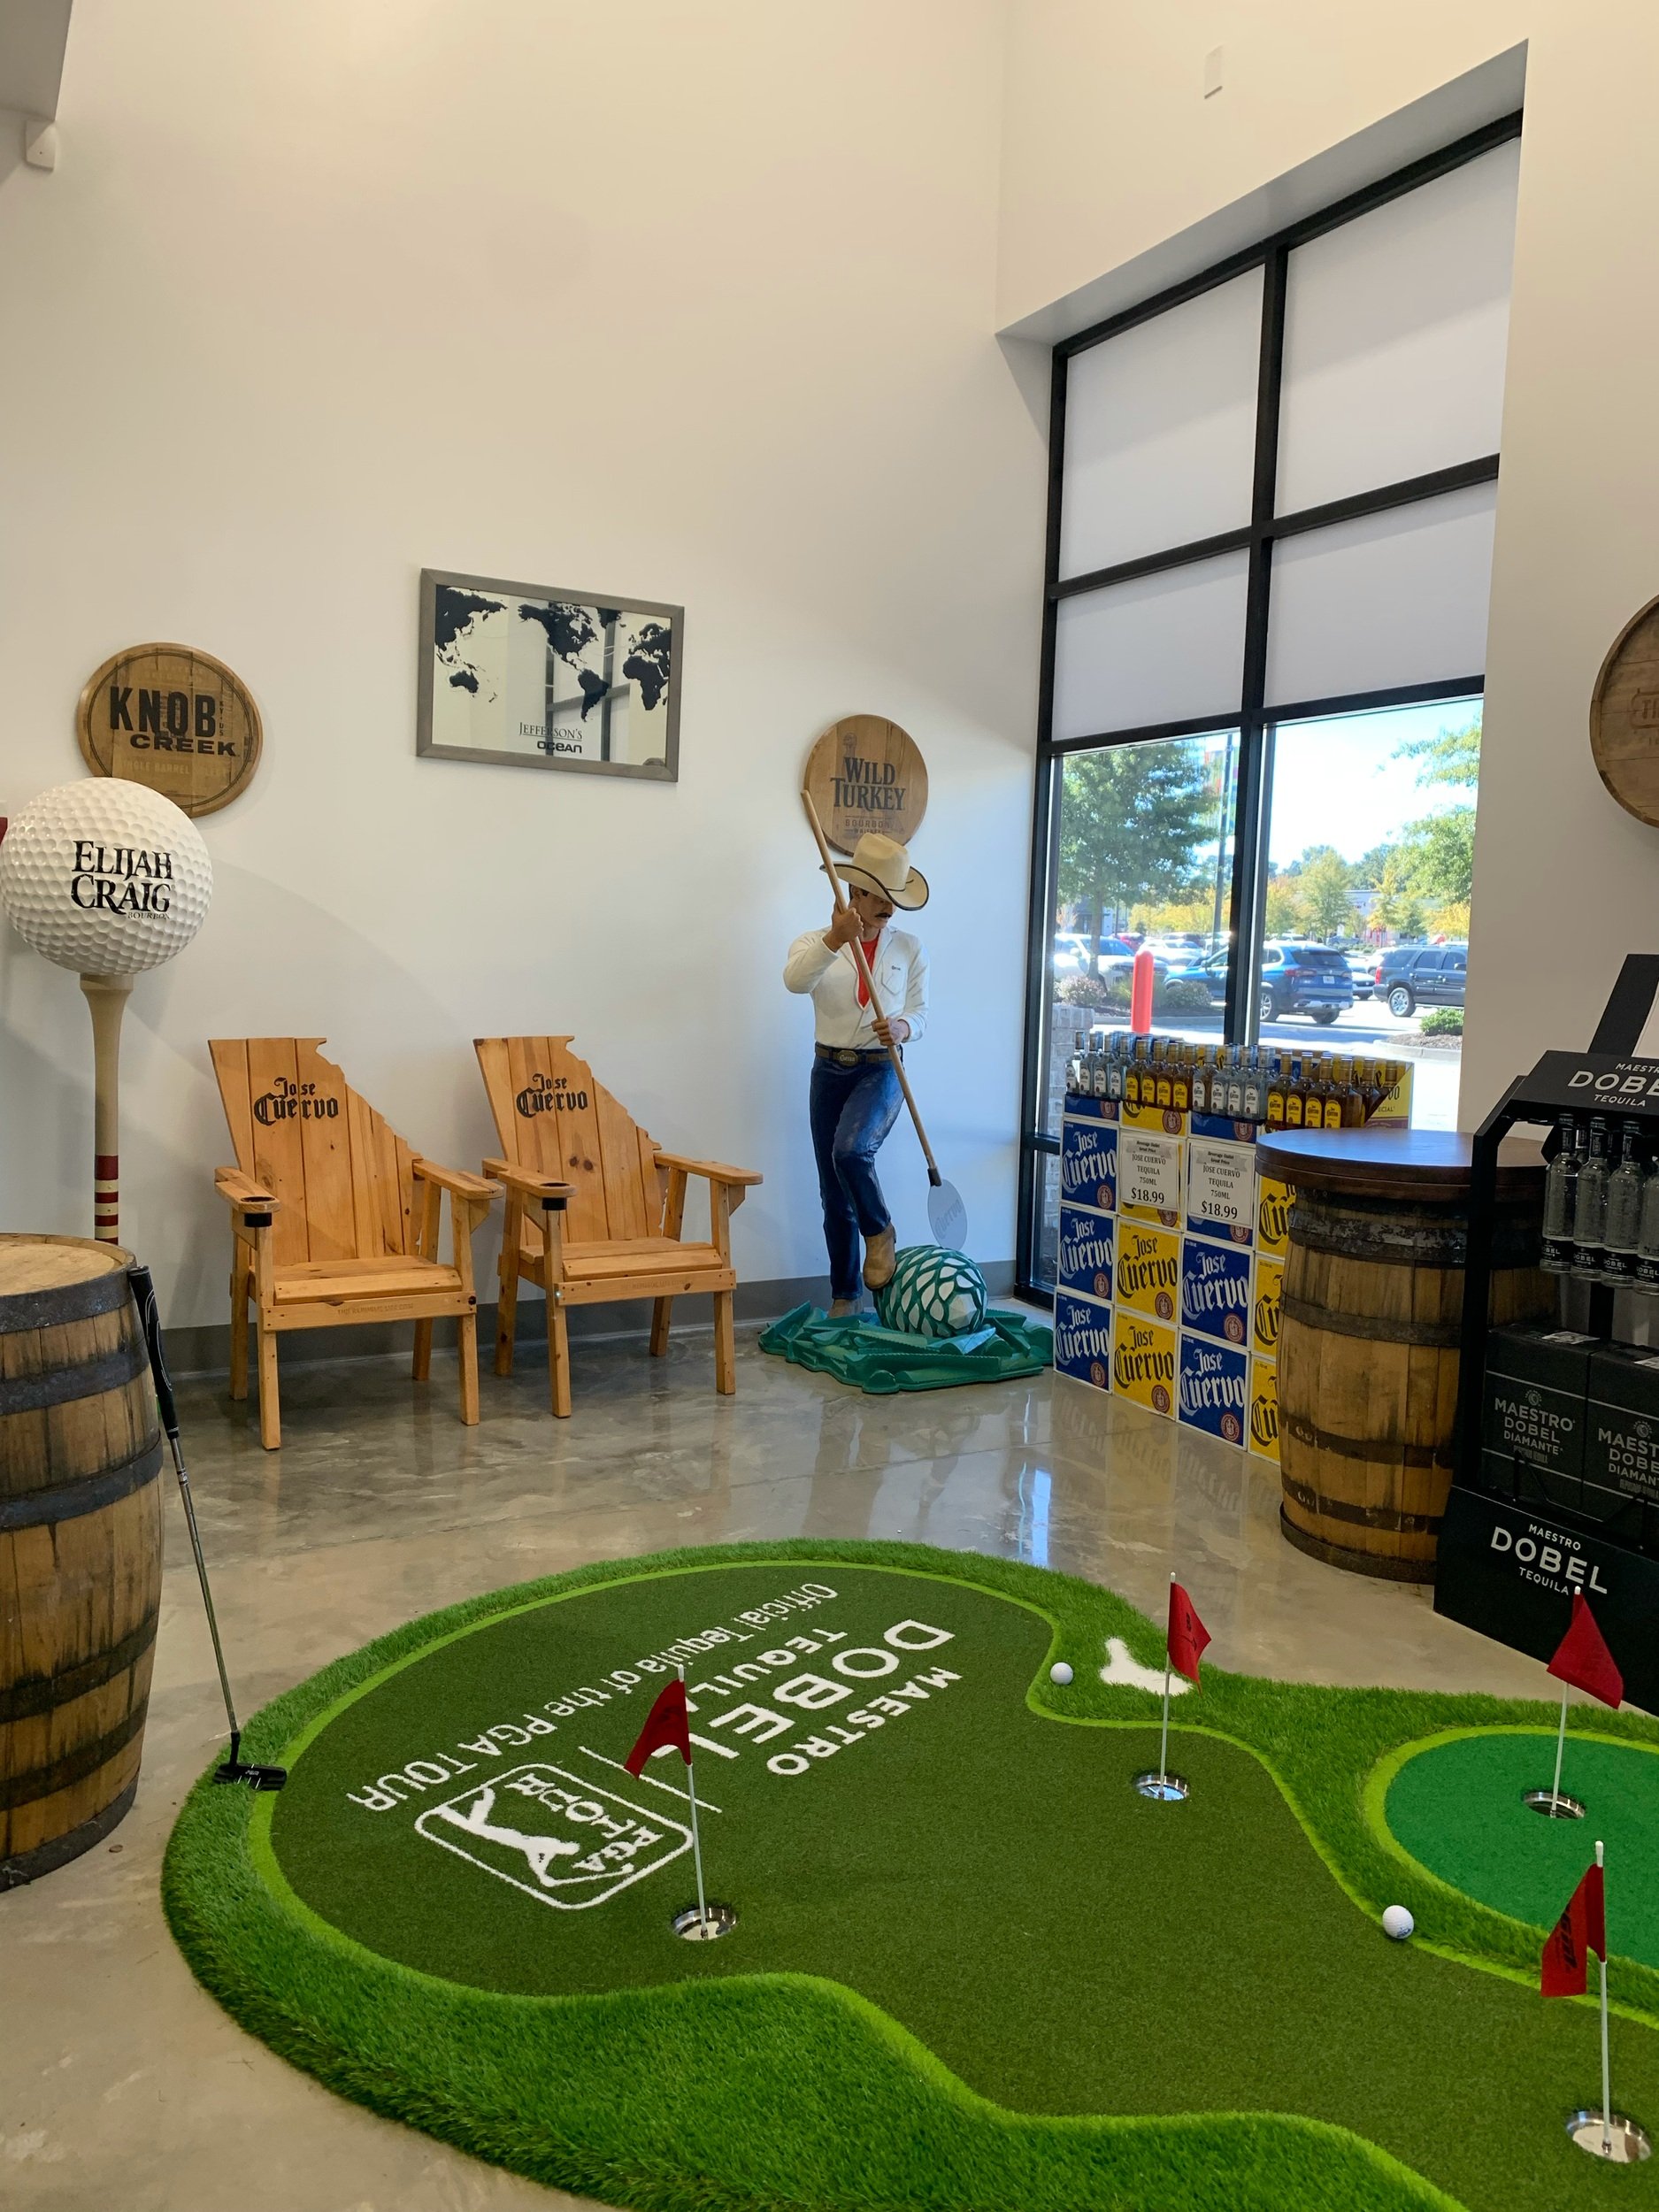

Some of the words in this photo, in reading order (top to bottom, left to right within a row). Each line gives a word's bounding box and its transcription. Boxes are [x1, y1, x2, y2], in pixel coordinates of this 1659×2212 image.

[110, 686, 216, 738] KNOB
[130, 733, 236, 757] CREEK
[843, 757, 896, 786] WILD
[830, 777, 907, 812] TURKEY
[71, 840, 173, 881] ELIJAH
[71, 873, 172, 915] CRAIG
[127, 911, 171, 920] BOURBON
[533, 1072, 567, 1094] Jose
[1567, 1070, 1659, 1096] DOBE
[1615, 1063, 1659, 1074] MAESTR
[273, 1076, 317, 1099] Jose
[1593, 1094, 1647, 1107] TEQUILA
[253, 1092, 339, 1126] Cuervo
[516, 1087, 588, 1118] Cuervo
[1071, 1130, 1098, 1157] Jose
[1062, 1148, 1117, 1194] Cuervo
[1132, 1153, 1143, 1162] JOSE
[1144, 1156, 1166, 1165] CUERVO
[1137, 1164, 1161, 1175] TEQUILA
[1202, 1164, 1216, 1173] JOSE
[1216, 1167, 1241, 1179] CUERVO
[1131, 1187, 1164, 1204] $18.99
[1139, 1176, 1158, 1186] 750ML
[1208, 1177, 1234, 1188] TEQUILA
[1210, 1189, 1231, 1200] 750ML
[1201, 1200, 1239, 1219] $18.99
[1071, 1217, 1095, 1243] Jose
[1061, 1233, 1113, 1279] Cuervo
[1131, 1233, 1158, 1261] Jose
[1117, 1252, 1177, 1299] Cuervo
[1195, 1251, 1226, 1279] Jose
[1181, 1270, 1248, 1320] Cuervo
[1066, 1304, 1091, 1330] Jose
[1056, 1320, 1110, 1366] Cuervo
[1128, 1325, 1154, 1351] Jose
[1114, 1342, 1174, 1389] Cuervo
[1193, 1348, 1223, 1377] Jose
[1179, 1365, 1246, 1416] Cuervo
[1494, 1397, 1573, 1432] MAESTRO
[1503, 1430, 1560, 1455] DIAMANTE
[1504, 1416, 1561, 1444] DOBEL
[1598, 1427, 1659, 1458] MAEST
[1608, 1462, 1659, 1486] DIAMAN
[1609, 1448, 1659, 1475] DOBE
[1528, 1524, 1582, 1552] MAESTRO
[1490, 1525, 1608, 1594] DOBEL
[1518, 1566, 1570, 1596] TEQUILA
[733, 1583, 839, 1631] Official
[634, 1626, 755, 1673] Tequila
[600, 1670, 642, 1694] of
[686, 1628, 849, 1713] TEQUIL
[543, 1686, 612, 1717] the
[457, 1713, 558, 1756] PGA
[766, 1666, 963, 1776] MAESTRO
[345, 1752, 479, 1811] TOUR
[503, 1772, 637, 1839] TOUR
[572, 1825, 664, 1872] PGA
